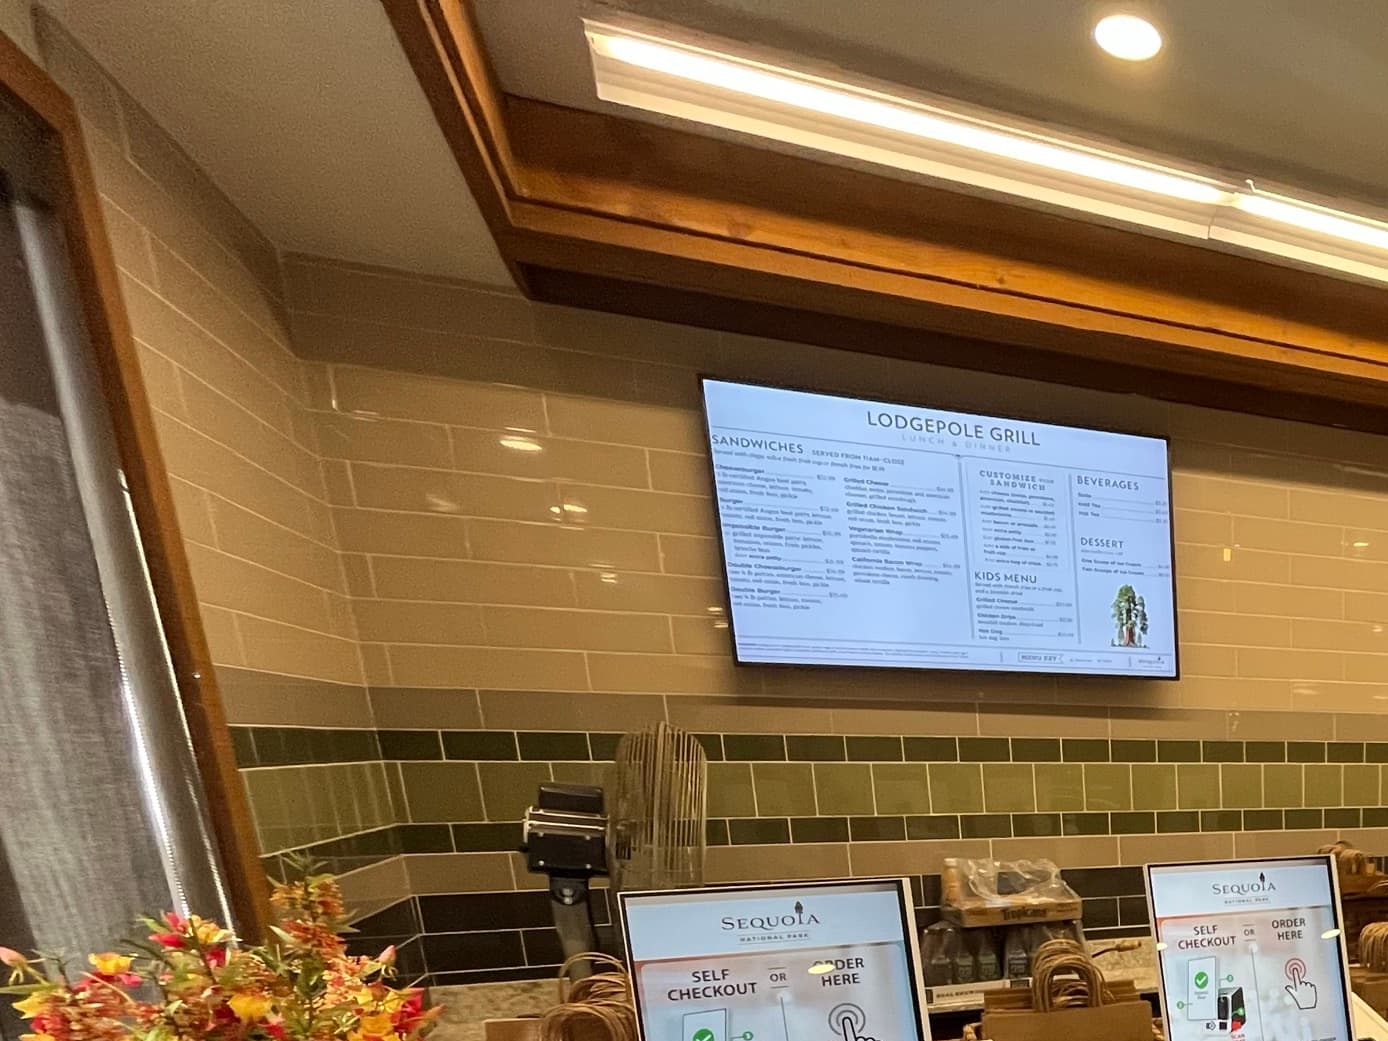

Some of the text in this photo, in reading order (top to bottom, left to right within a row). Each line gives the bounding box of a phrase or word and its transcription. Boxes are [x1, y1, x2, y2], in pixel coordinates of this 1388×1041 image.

[867, 410, 1041, 446] LODGEPOLE GRILL
[712, 434, 804, 454] SANDWICHES
[812, 450, 840, 458] SERVED
[901, 434, 944, 446] LUNCH
[965, 442, 1011, 453] DINNER
[979, 470, 1036, 482] CUSTOMIZE
[1076, 475, 1140, 490] BEVERAGES
[990, 480, 1046, 490] SANDWICH
[1080, 537, 1124, 548] DESSERT
[974, 572, 1037, 584] KIDS MENU
[1212, 882, 1276, 896] SEQUOIA
[721, 912, 820, 930] SEQUOIA
[1003, 907, 1048, 921] Tropicana
[1193, 924, 1218, 936] SELF
[1271, 918, 1306, 929] ORDER
[1277, 930, 1303, 940] HERE
[1178, 936, 1236, 950] CHECKOUT
[692, 968, 786, 983] SELF OR
[822, 974, 861, 986] HERE
[667, 982, 758, 1002] CHECKOUT
